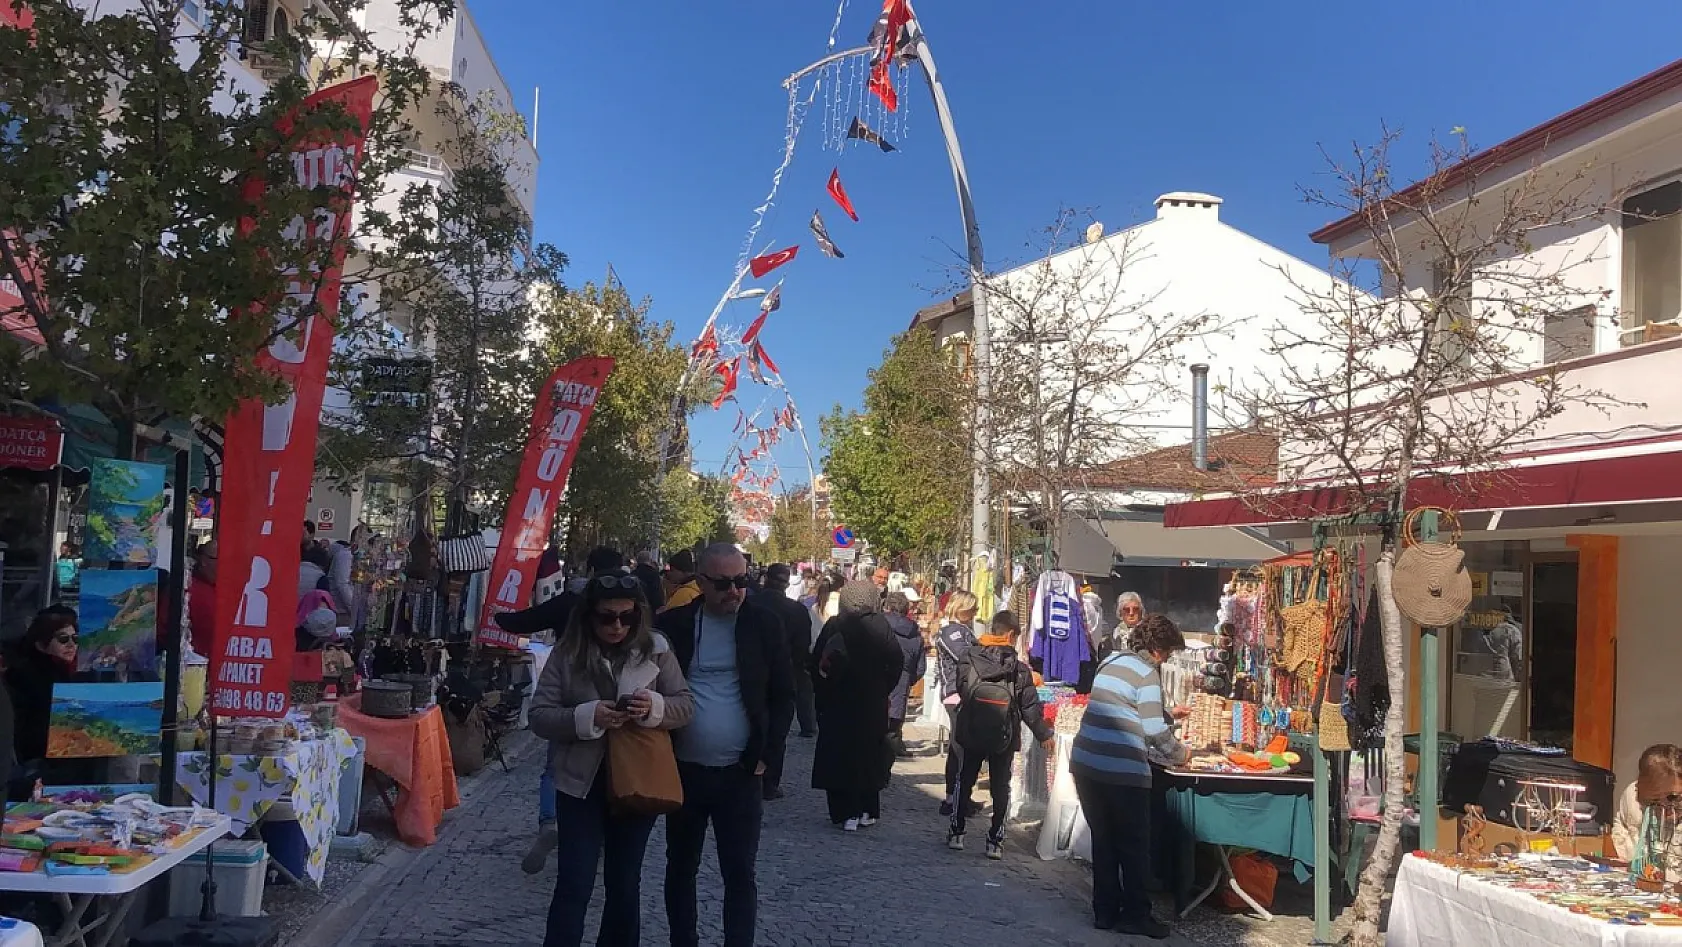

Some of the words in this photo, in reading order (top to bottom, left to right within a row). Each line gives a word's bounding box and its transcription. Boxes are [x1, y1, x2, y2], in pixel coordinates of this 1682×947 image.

[224, 635, 274, 659] RBA
[244, 690, 263, 712] 48
[266, 691, 286, 713] 63
